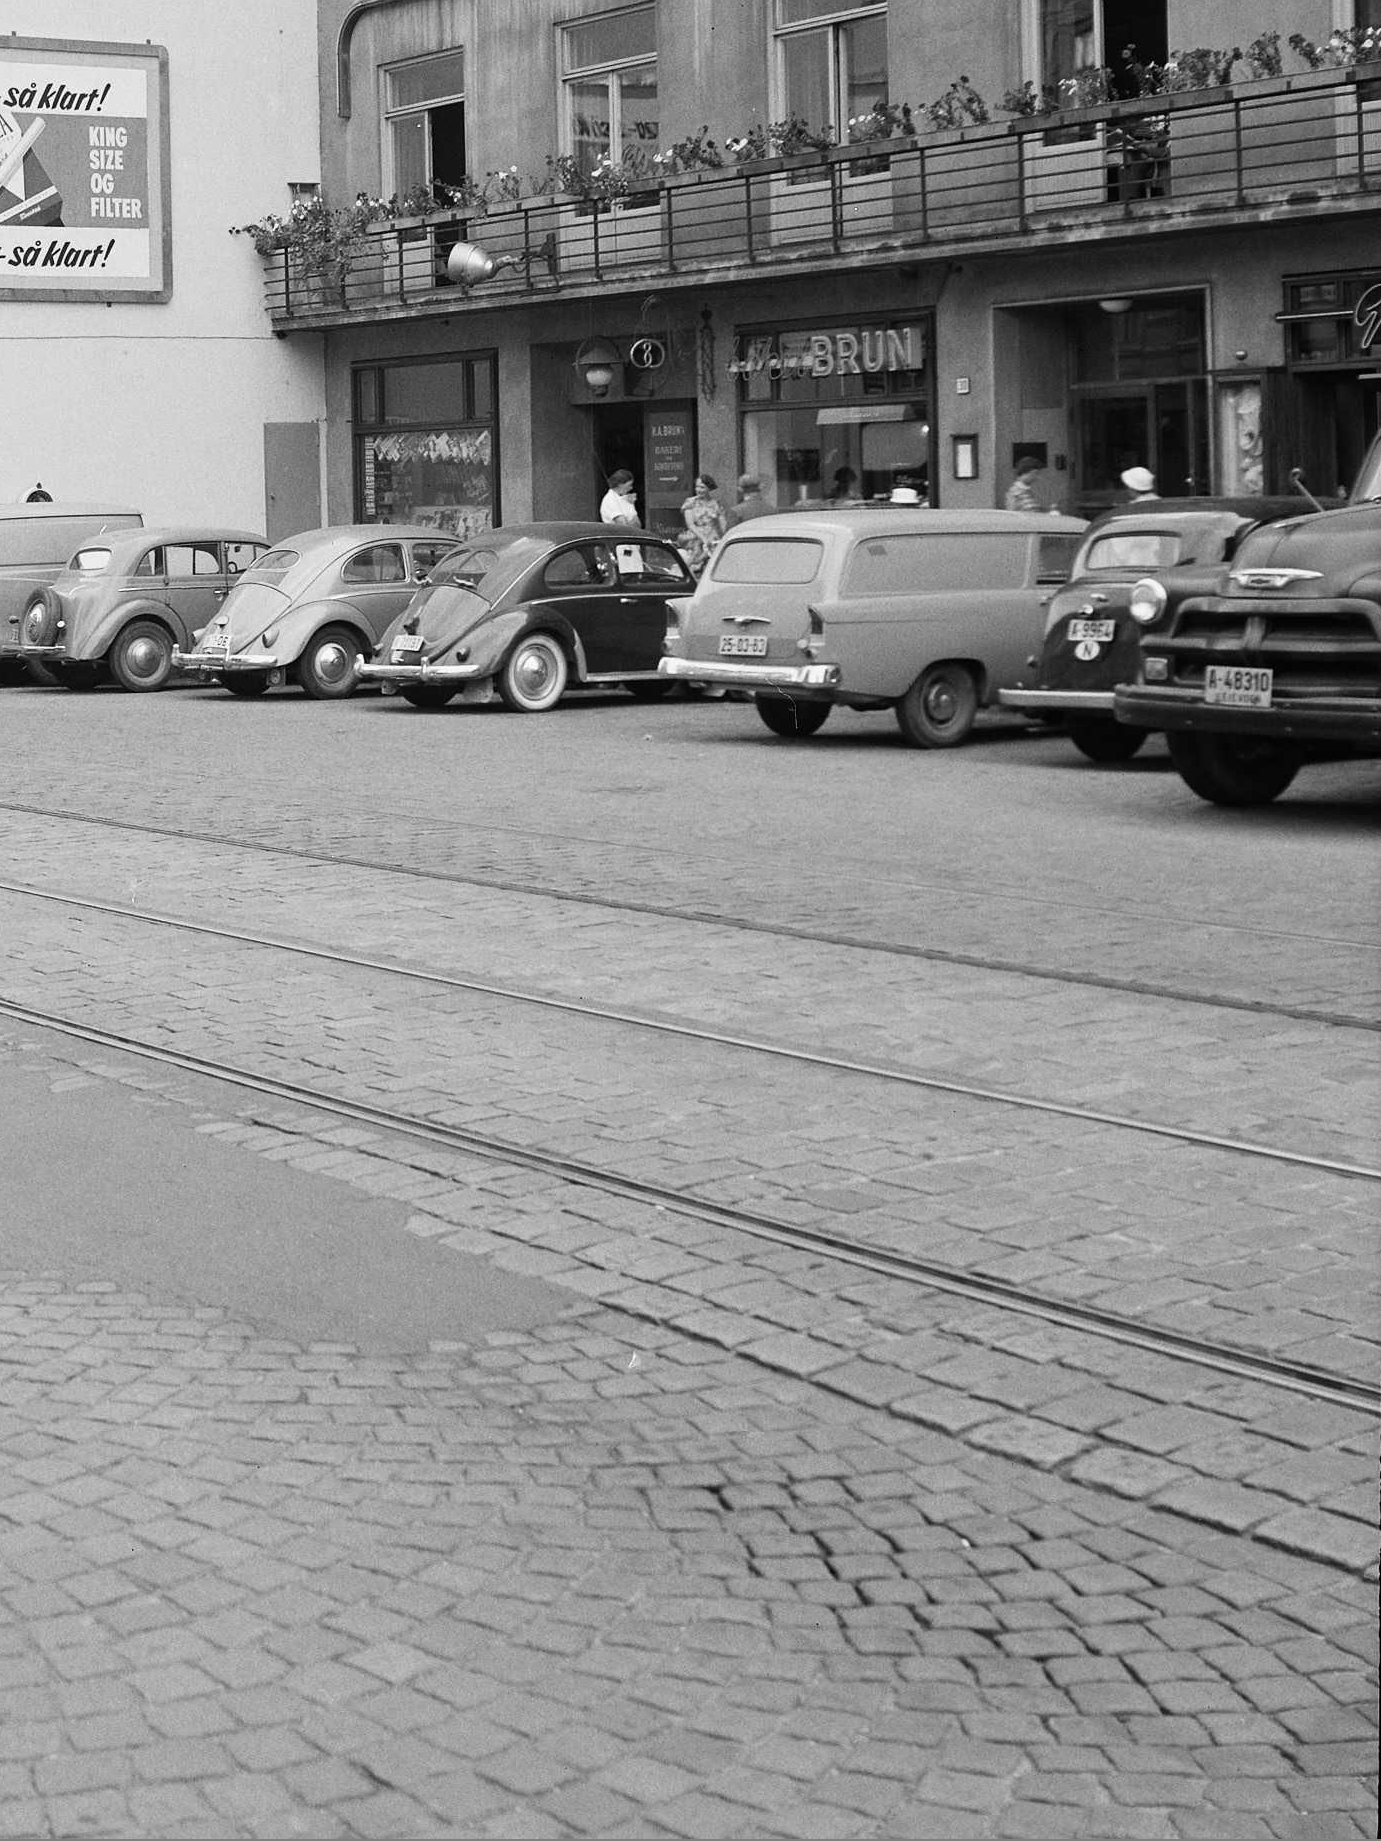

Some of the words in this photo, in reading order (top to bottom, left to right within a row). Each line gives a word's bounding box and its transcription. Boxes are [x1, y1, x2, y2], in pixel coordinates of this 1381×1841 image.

[40, 82, 111, 112] klart!
[89, 126, 128, 147] KING
[89, 149, 124, 170] SIZE
[90, 173, 115, 193] OG
[90, 198, 142, 218] FILTER
[43, 238, 115, 268] klart!
[811, 327, 912, 378] BRUN
[1083, 643, 1094, 657] N
[1209, 669, 1270, 692] A-48310
